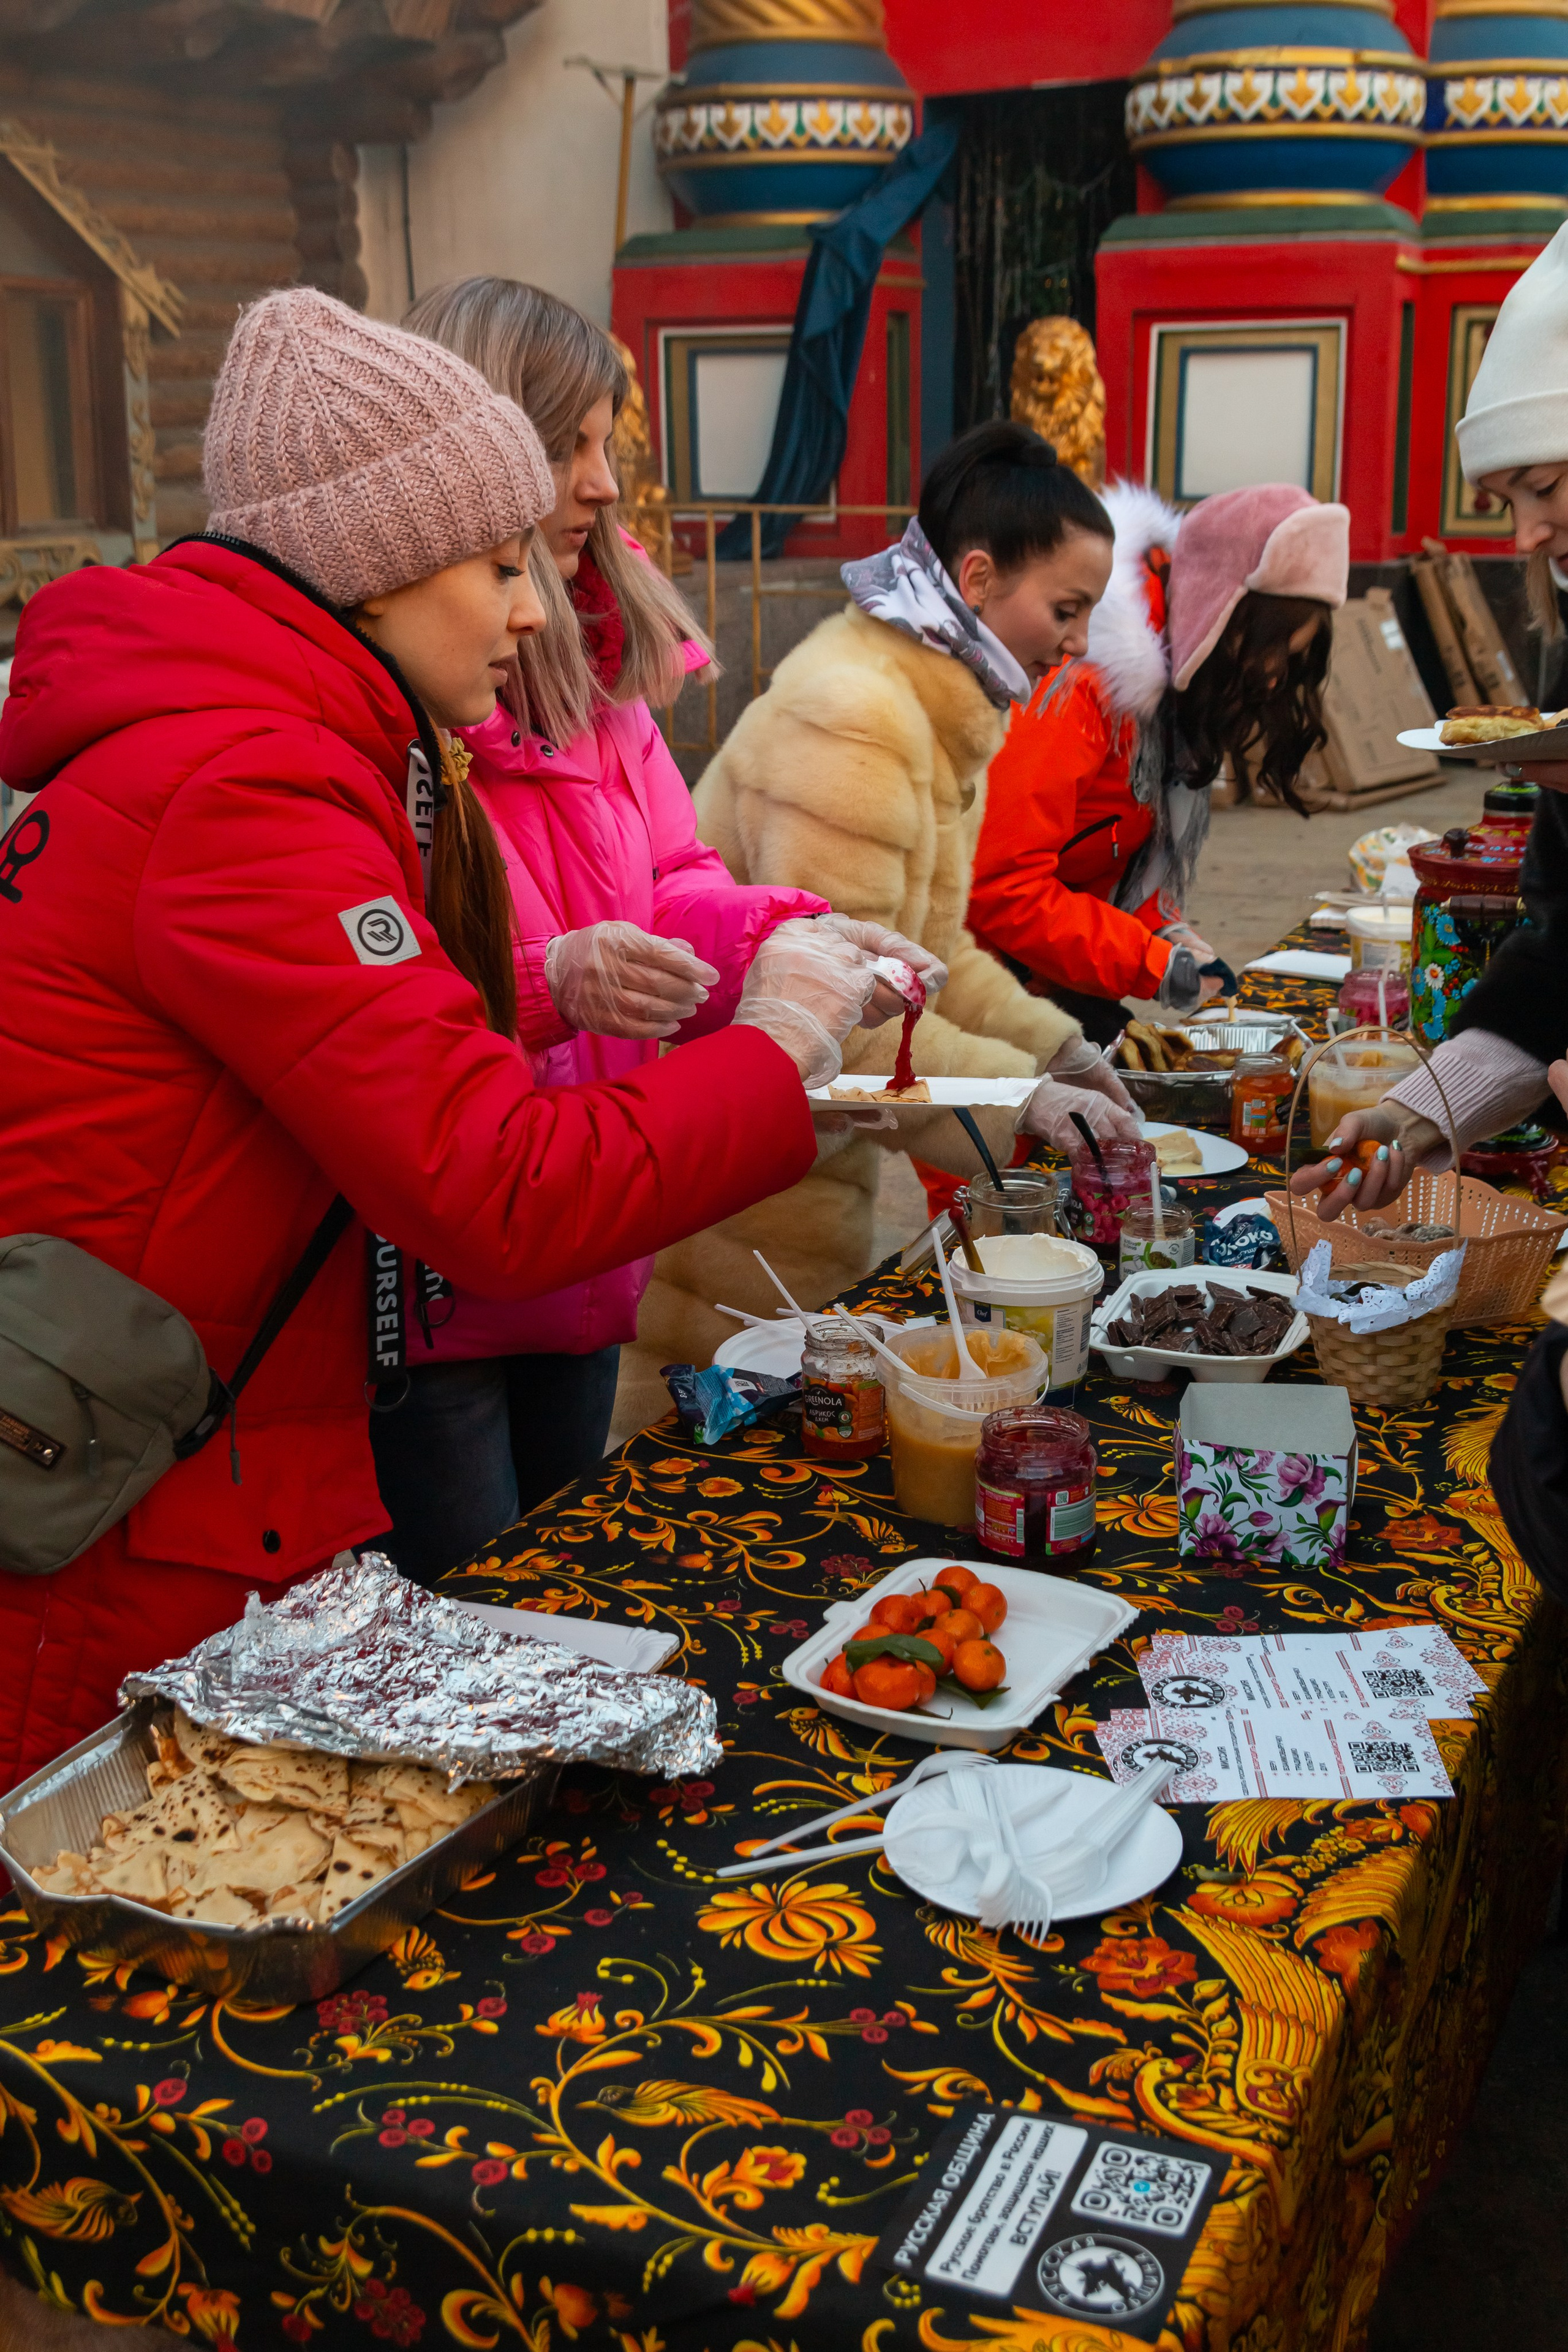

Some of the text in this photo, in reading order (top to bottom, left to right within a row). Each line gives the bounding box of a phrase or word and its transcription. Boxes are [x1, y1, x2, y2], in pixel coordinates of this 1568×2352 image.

[804, 1395, 842, 1406] GREENOLA
[809, 1409, 835, 1418] АБРИКОС
[1241, 1679, 1255, 1700] МИССИЯ
[1217, 1746, 1230, 1769] МИССИЯ
[894, 2113, 996, 2266] РУССКАЯ ОБЩИНА
[940, 2122, 1032, 2273] Русское братство в России
[1009, 2168, 1062, 2245] ВСТУПАЙ!
